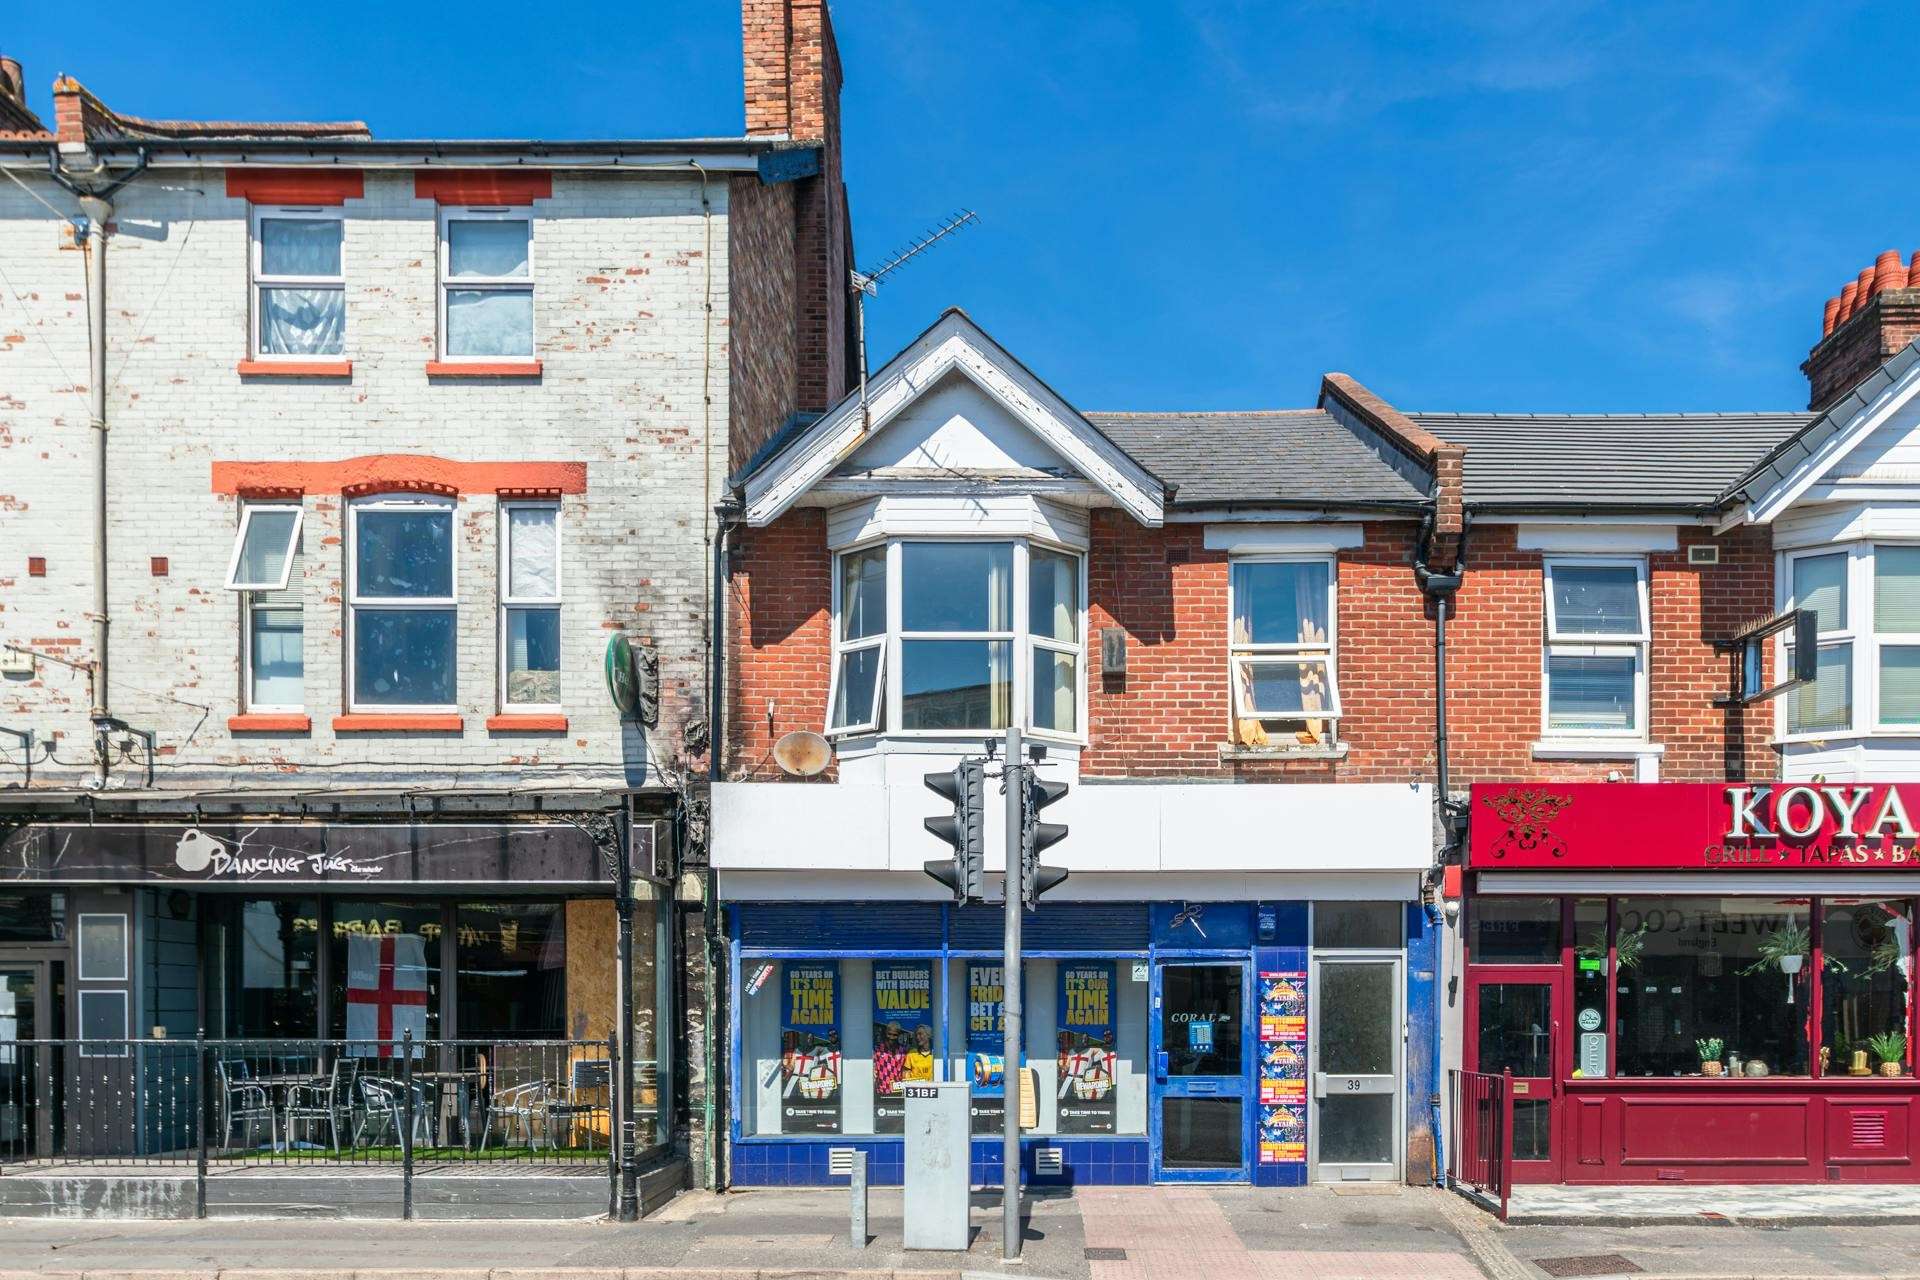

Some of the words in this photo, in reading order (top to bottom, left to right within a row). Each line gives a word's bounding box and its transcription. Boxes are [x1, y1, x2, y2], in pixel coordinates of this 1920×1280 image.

[1726, 785, 1920, 838] KOYA
[1704, 845, 1772, 864] GRILL
[1797, 845, 1869, 863] TAPAS
[211, 851, 304, 875] DANCING
[307, 853, 352, 873] JUG
[802, 970, 822, 978] YEARS
[876, 971, 890, 979] BET
[892, 970, 929, 979] BUILDERS
[790, 979, 811, 989] IT'S
[813, 979, 832, 989] OUR
[876, 980, 897, 989] WITH
[900, 980, 929, 989] BIGGER
[1066, 979, 1086, 989] IT'S
[1088, 979, 1107, 989] OUR
[790, 989, 833, 1009] TIME
[876, 990, 929, 1009] VALUE
[971, 986, 1005, 1002] FRID
[1066, 989, 1108, 1009] TIME
[971, 1002, 994, 1016] BET
[791, 1009, 833, 1024] AGAIN
[1066, 1009, 1108, 1024] AGAIN
[1171, 1013, 1217, 1022] CORAL
[971, 1017, 994, 1031] GET
[1347, 1080, 1360, 1090] 39
[907, 1089, 937, 1098] 31BF
